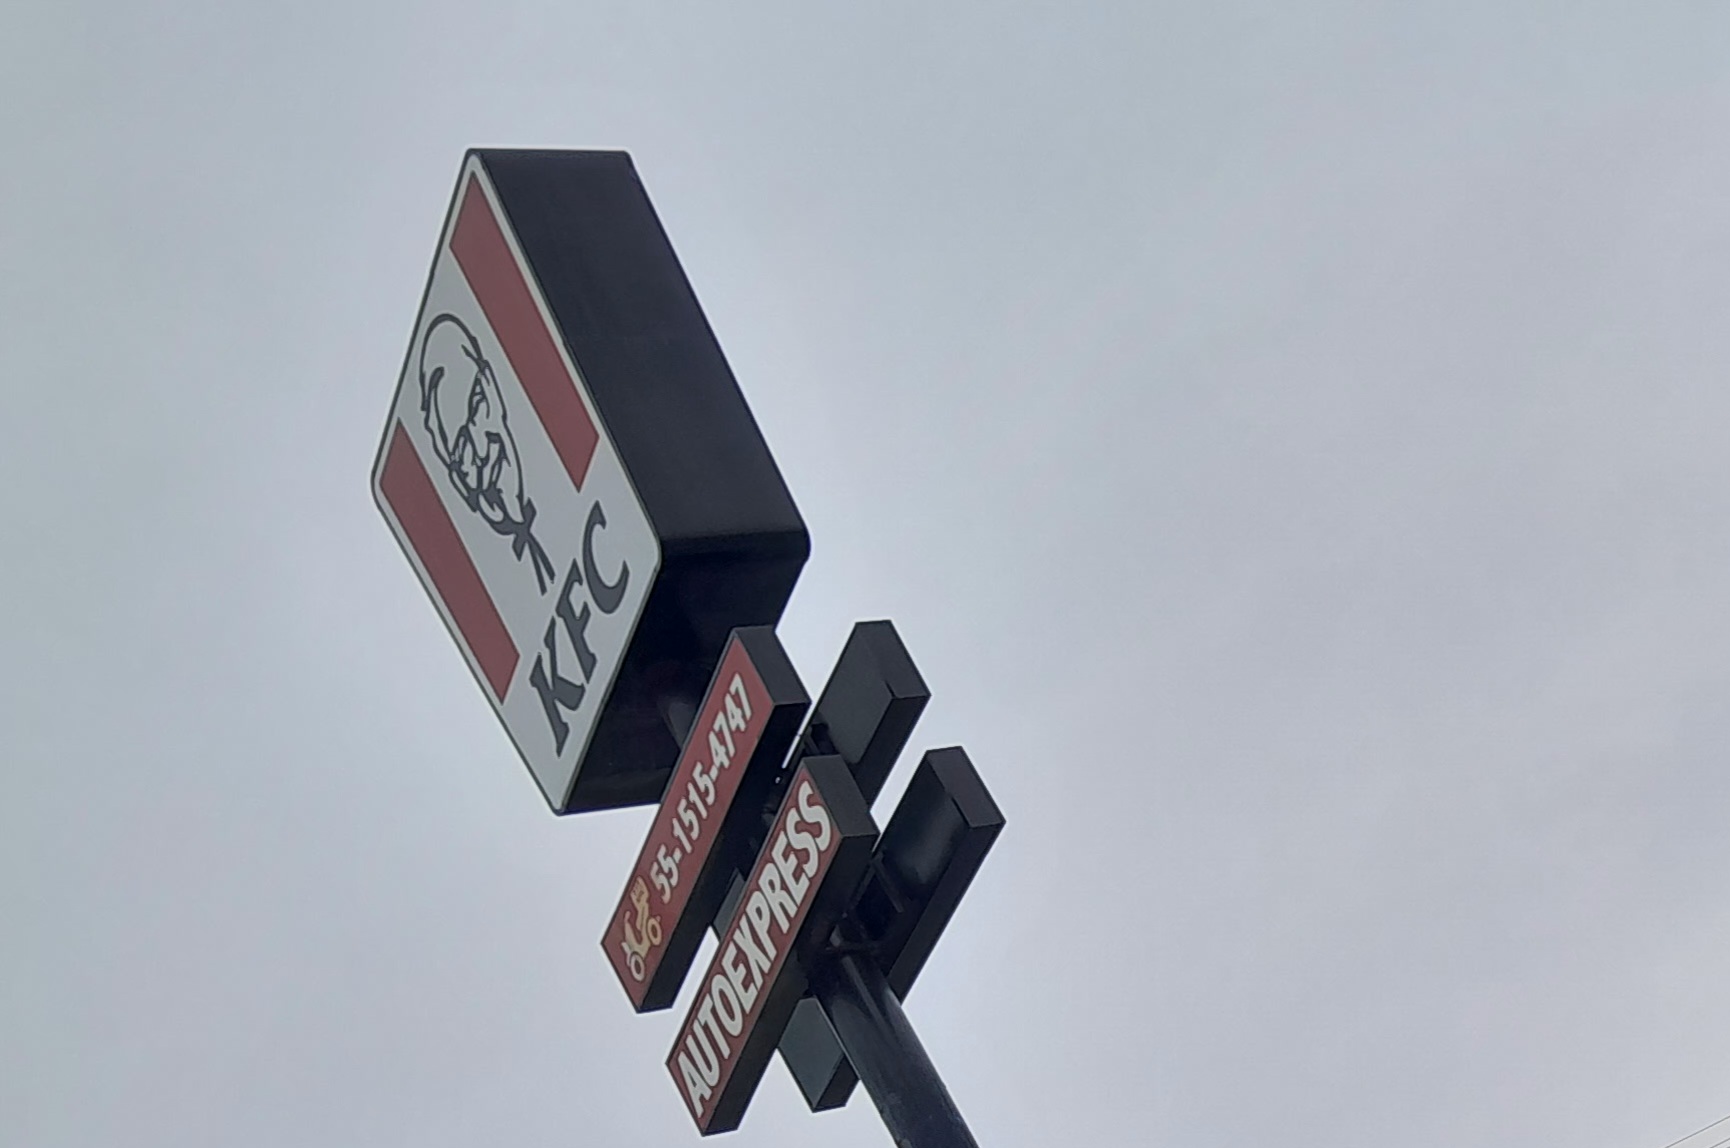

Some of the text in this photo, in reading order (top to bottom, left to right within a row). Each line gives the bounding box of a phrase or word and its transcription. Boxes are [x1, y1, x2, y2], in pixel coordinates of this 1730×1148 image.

[529, 499, 631, 758] KFC
[648, 672, 754, 905] 55-1515-4747
[676, 780, 832, 1119] AUTOEXPRESS
